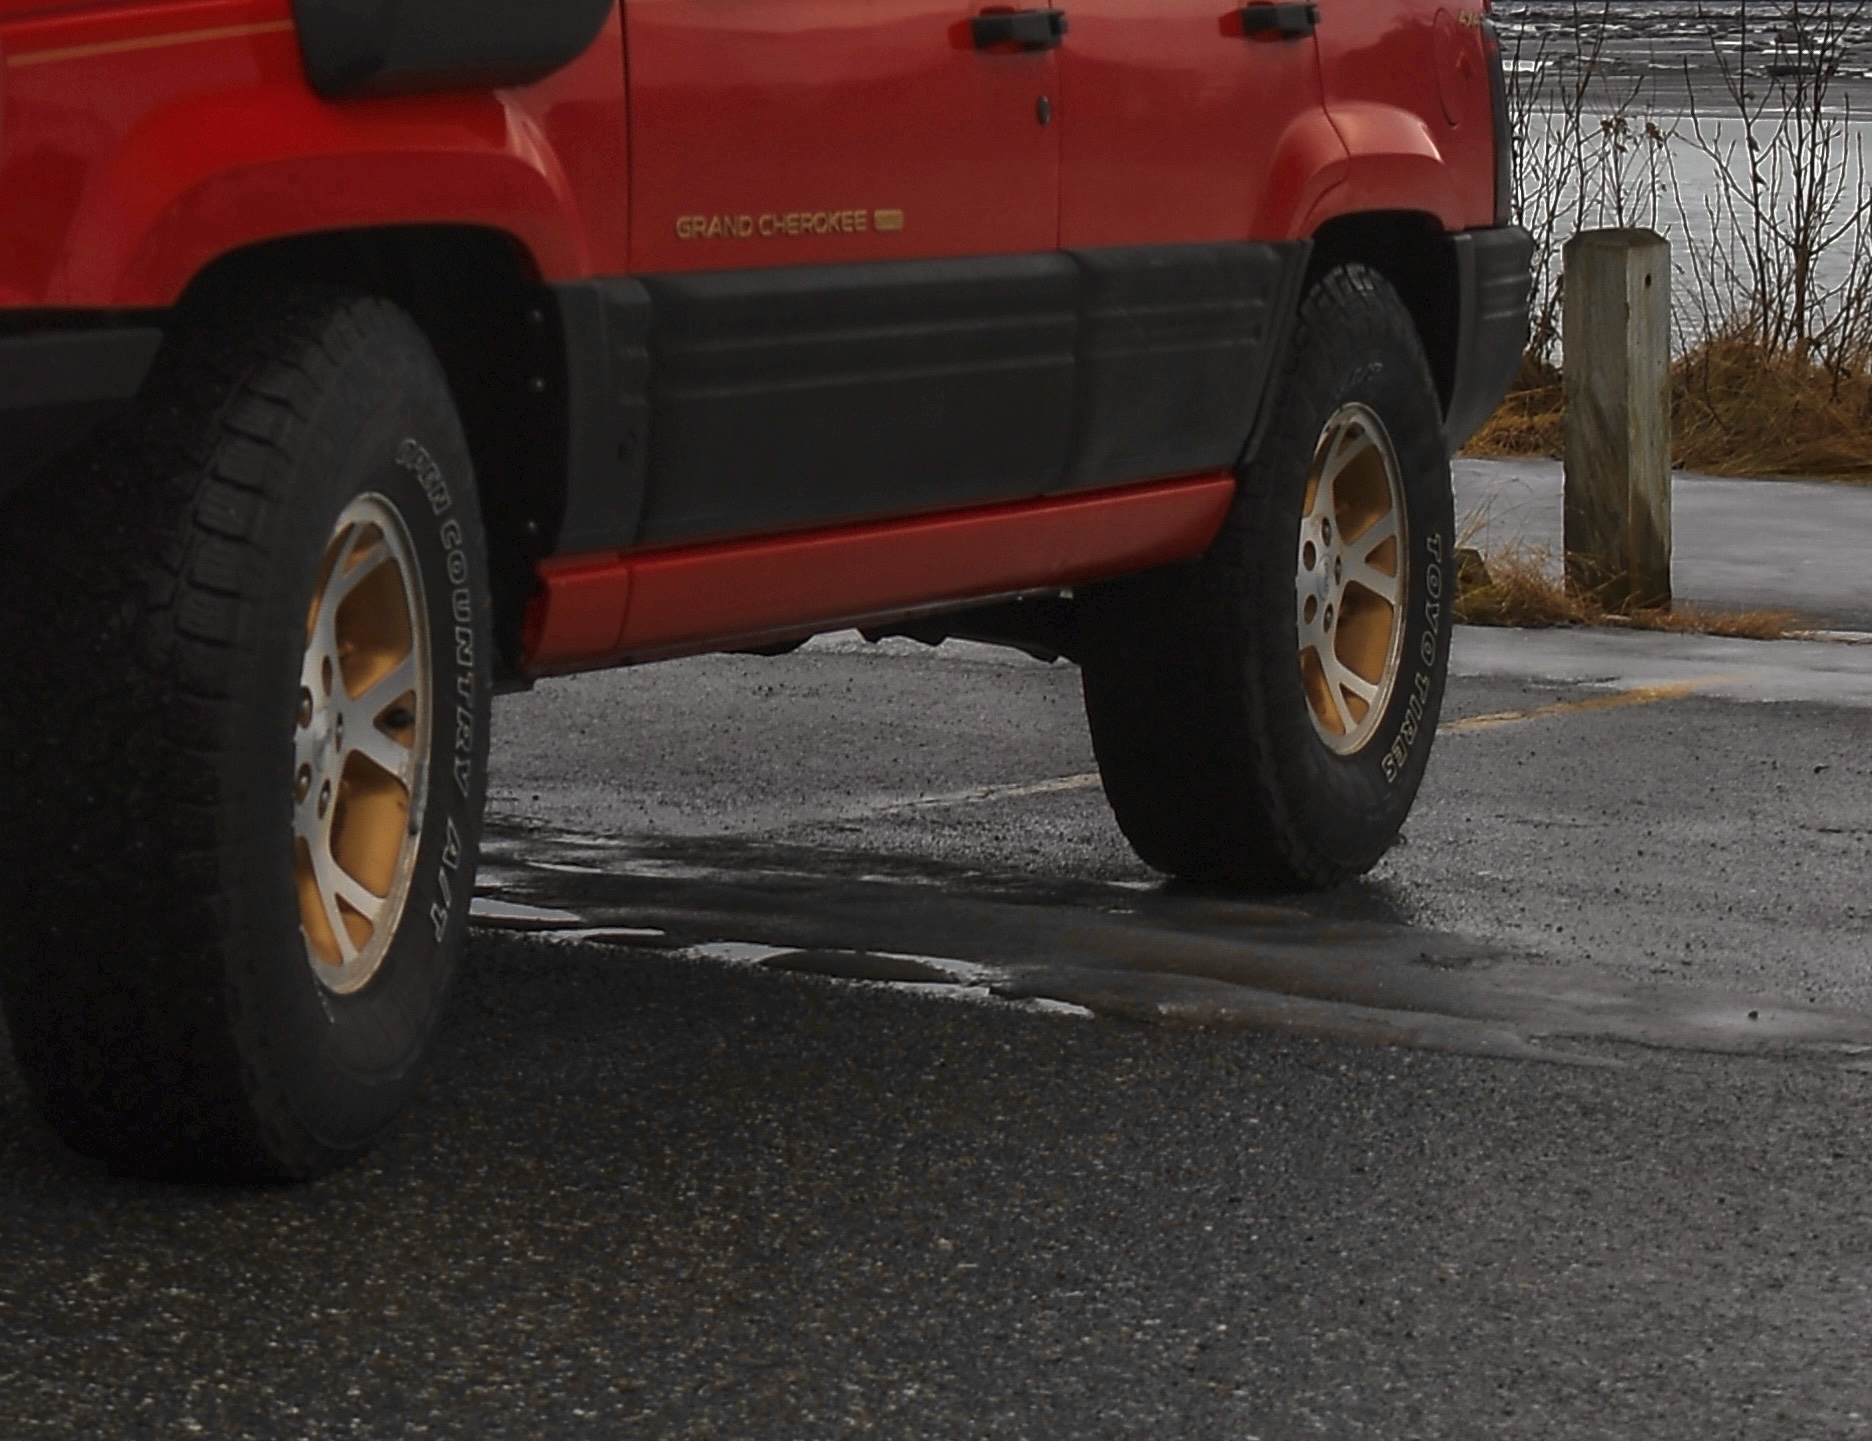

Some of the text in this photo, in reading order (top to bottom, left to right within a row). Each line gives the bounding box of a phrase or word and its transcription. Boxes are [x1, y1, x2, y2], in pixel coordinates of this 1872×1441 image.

[675, 209, 868, 240] GRAND CHEROKEE
[441, 518, 475, 798] COUNTRY
[1381, 532, 1442, 783] TOYO TIRES
